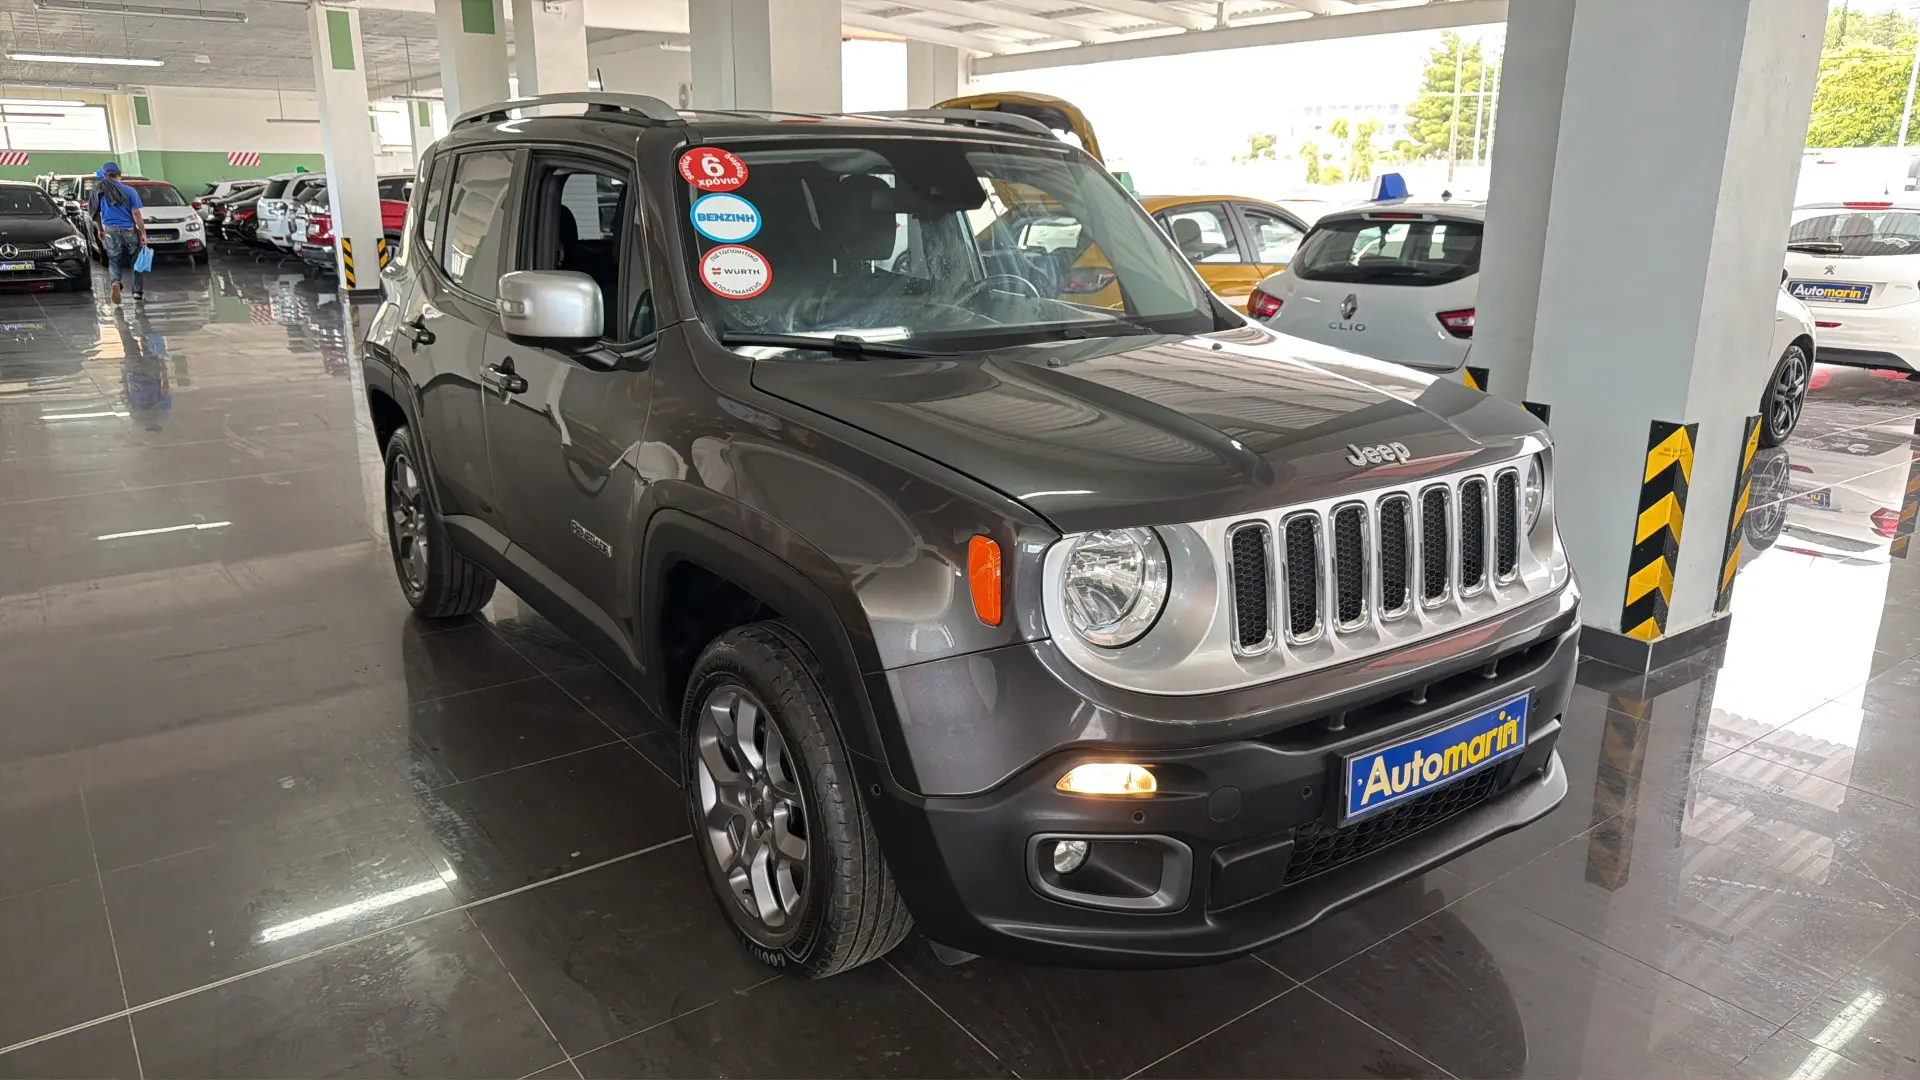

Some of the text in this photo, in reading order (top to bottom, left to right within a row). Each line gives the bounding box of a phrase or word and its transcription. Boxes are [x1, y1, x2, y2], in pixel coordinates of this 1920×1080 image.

[701, 156, 724, 177] 6
[697, 176, 739, 187] χρόνια
[697, 212, 755, 222] ΒΕΝΖΙΝΗ
[709, 248, 759, 263] ΠΙΣΤΟΠΟΙΗΤΙΚΟ
[712, 280, 762, 294] ΑΠΟΛΥΜΑΝΣΗΣ
[1793, 283, 1861, 299] Automarin
[1328, 322, 1366, 332] CLIO
[1346, 442, 1411, 467] Jeep
[1360, 710, 1518, 805] Automarin
